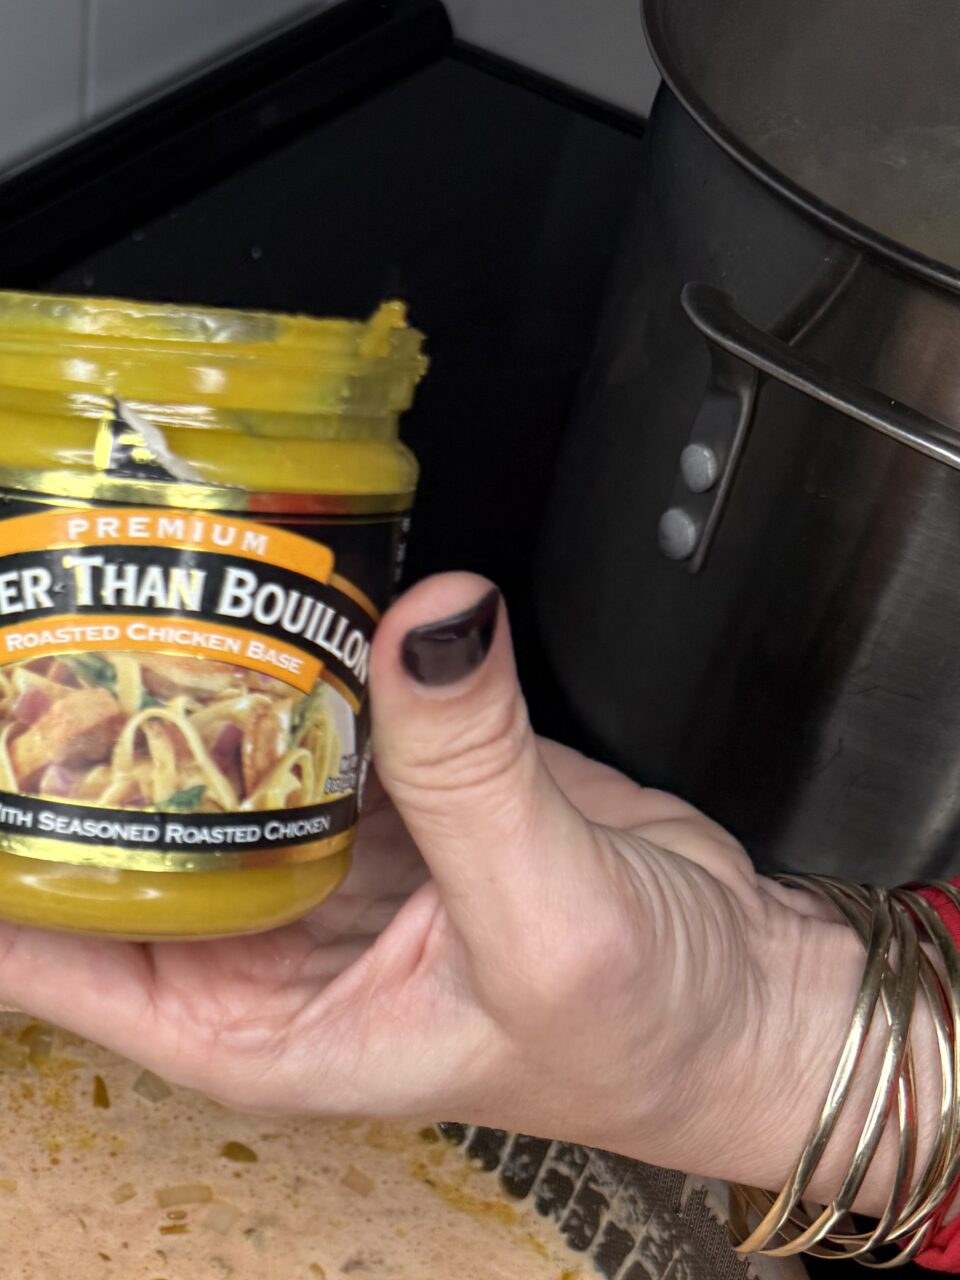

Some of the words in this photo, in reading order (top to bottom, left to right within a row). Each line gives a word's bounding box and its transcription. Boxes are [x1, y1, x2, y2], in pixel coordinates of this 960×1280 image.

[67, 518, 269, 556] PREMIUM
[62, 554, 207, 612] THAN
[5, 624, 121, 653] ROASTED
[125, 622, 241, 654] CHICKEN
[246, 641, 302, 676] BASE
[37, 809, 160, 843] SEASONED
[164, 824, 262, 844] ROASTED
[264, 815, 332, 840] CHICKEN
